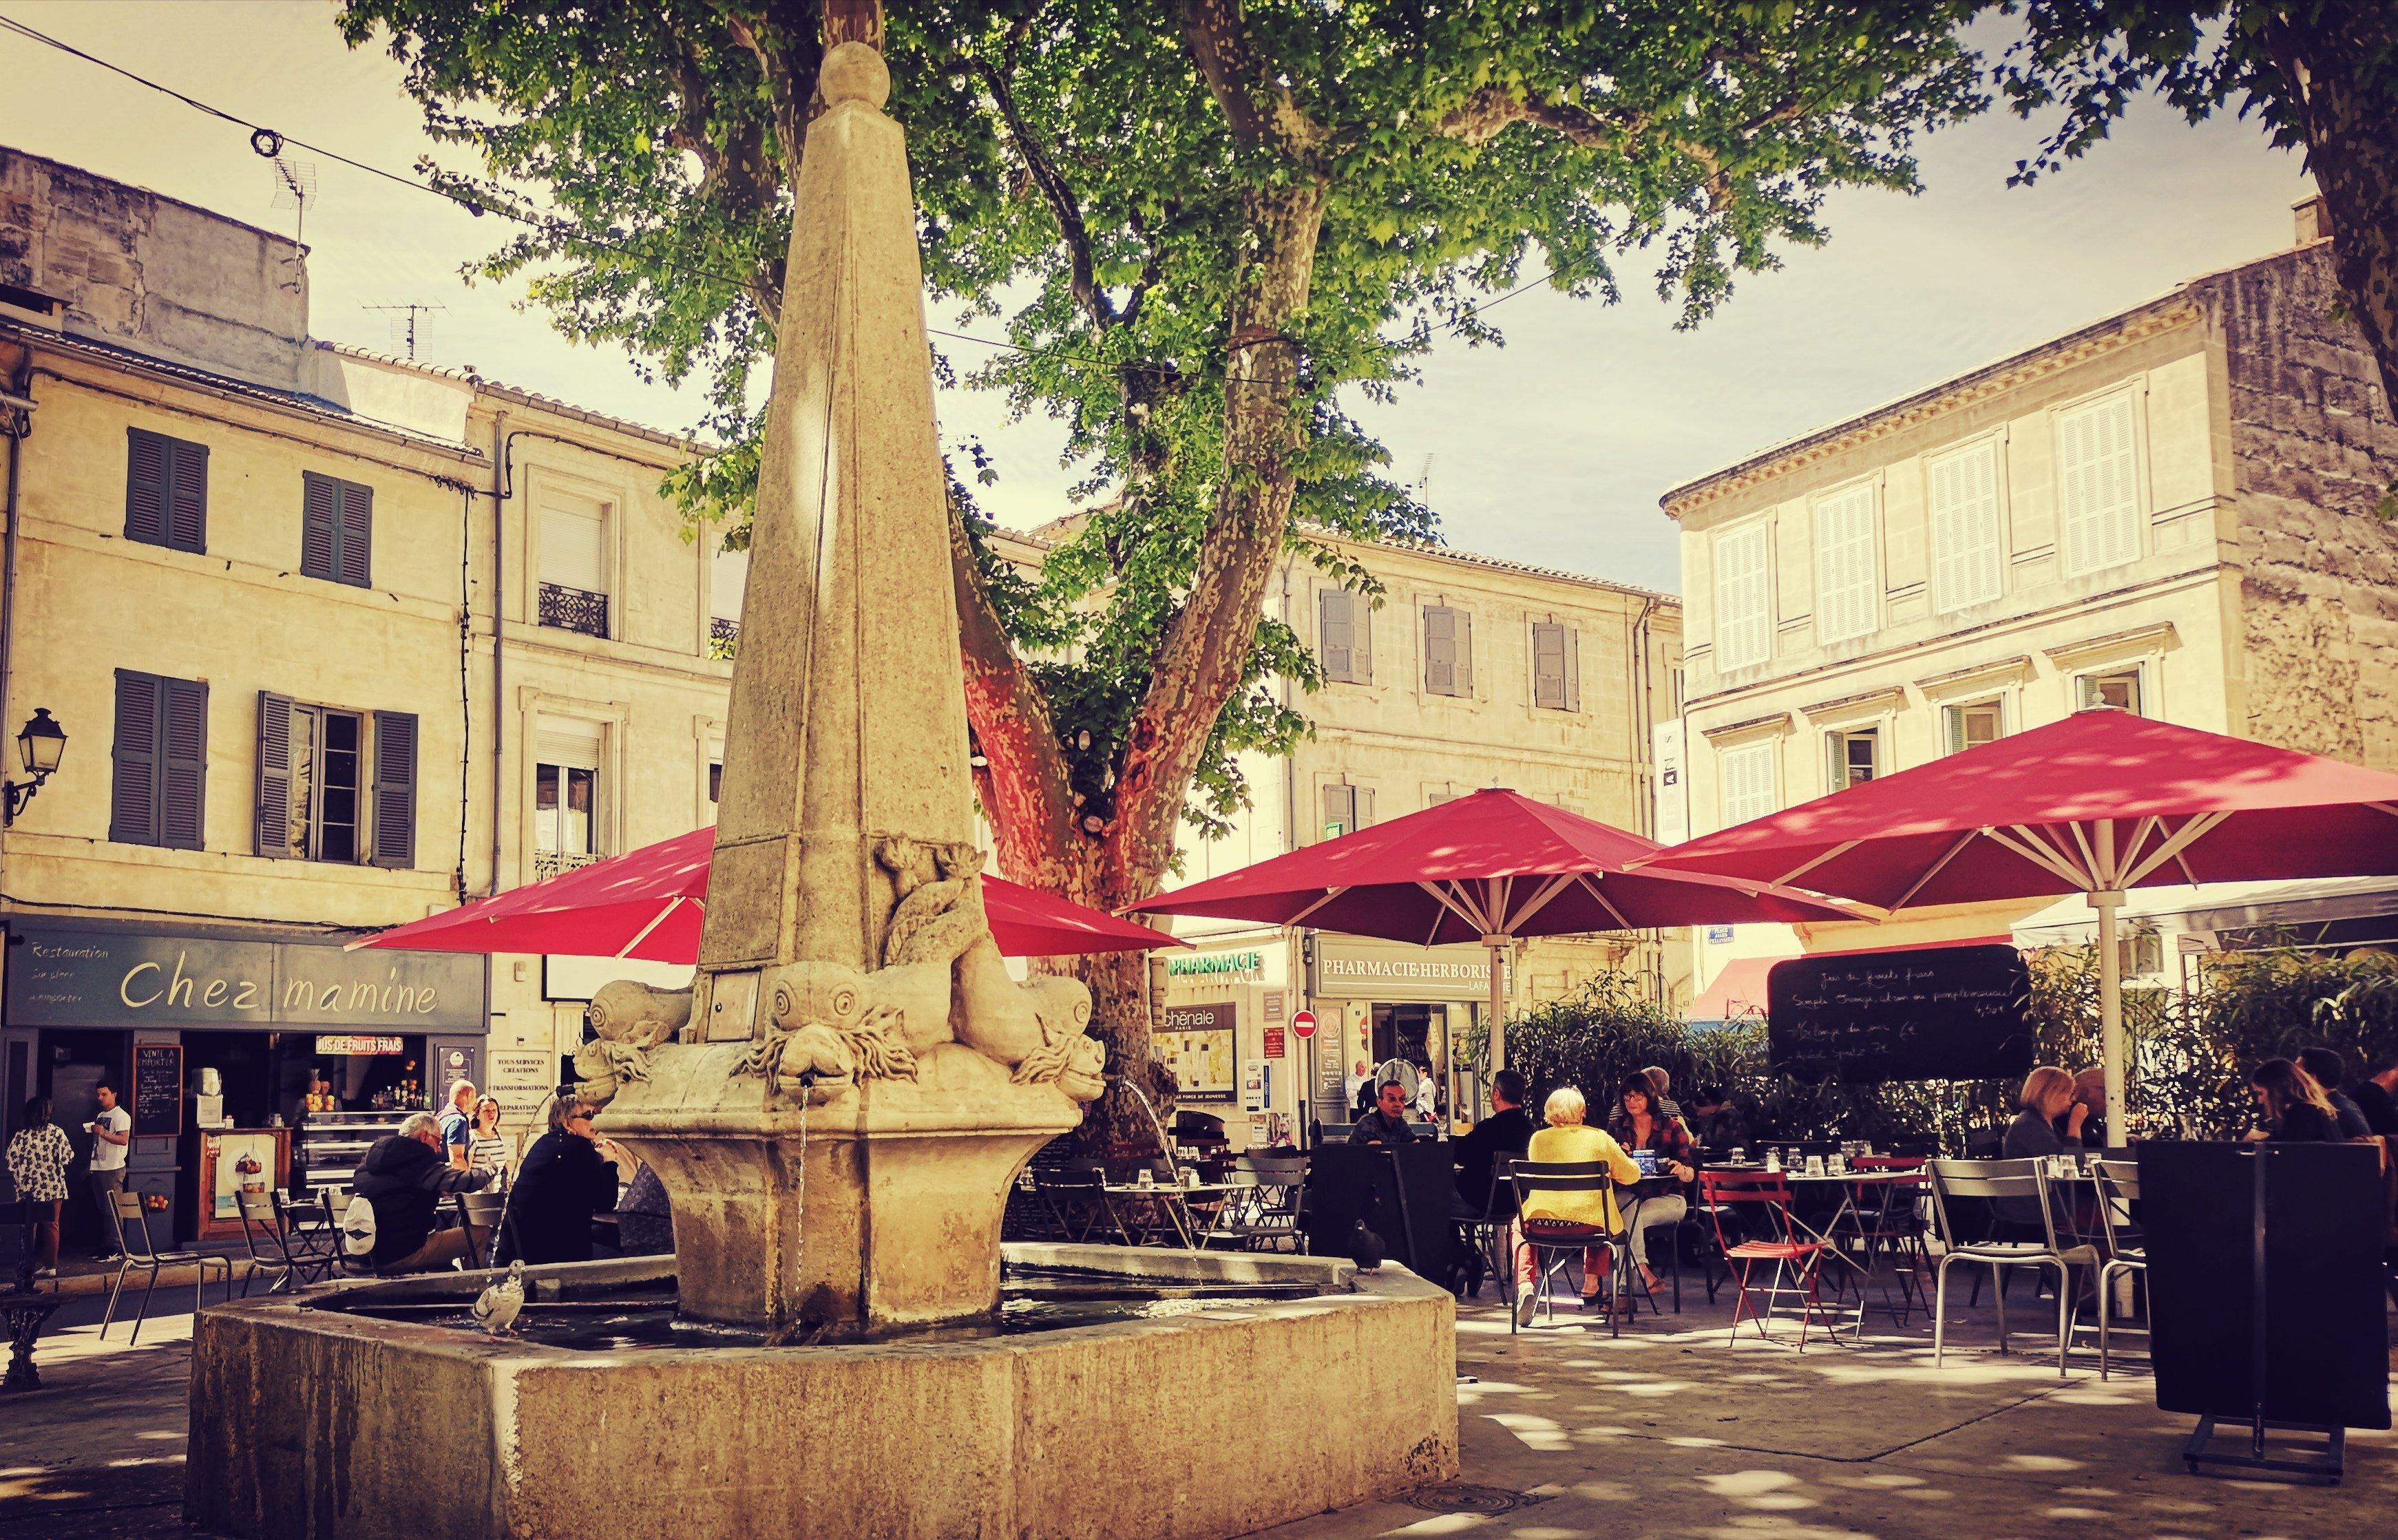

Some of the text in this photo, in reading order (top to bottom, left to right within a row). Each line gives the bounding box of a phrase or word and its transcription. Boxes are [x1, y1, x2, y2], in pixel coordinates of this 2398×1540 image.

[32, 941, 109, 959] Restauration
[1168, 951, 1259, 975] PHARMACIE
[120, 949, 439, 1014] Chez mamine
[348, 1039, 377, 1053] FRUITS
